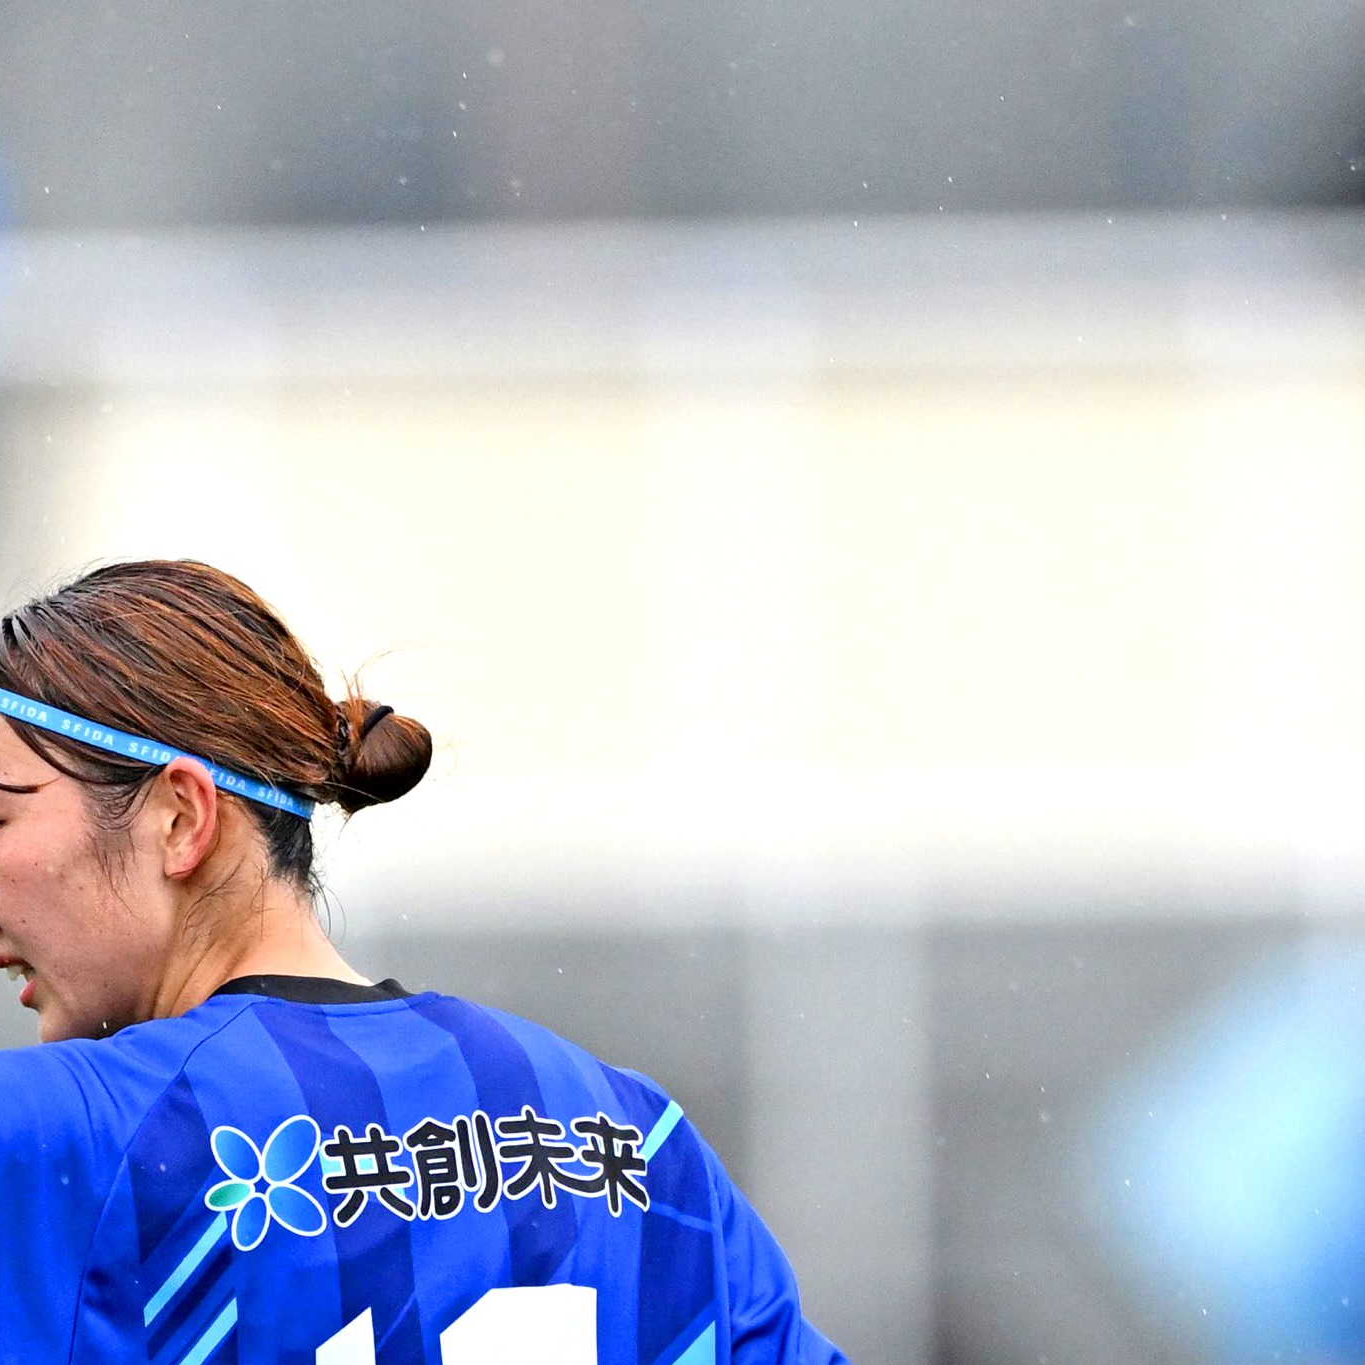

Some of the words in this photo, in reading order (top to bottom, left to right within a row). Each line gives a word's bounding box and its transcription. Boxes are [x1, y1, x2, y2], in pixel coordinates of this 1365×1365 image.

[1, 698, 47, 722] SFIDA
[62, 719, 114, 746] SFIDA
[128, 742, 180, 761] SFID
[208, 765, 246, 791] FIDA
[257, 787, 293, 807] SFIDA
[321, 1105, 649, 1226] 共創未来
